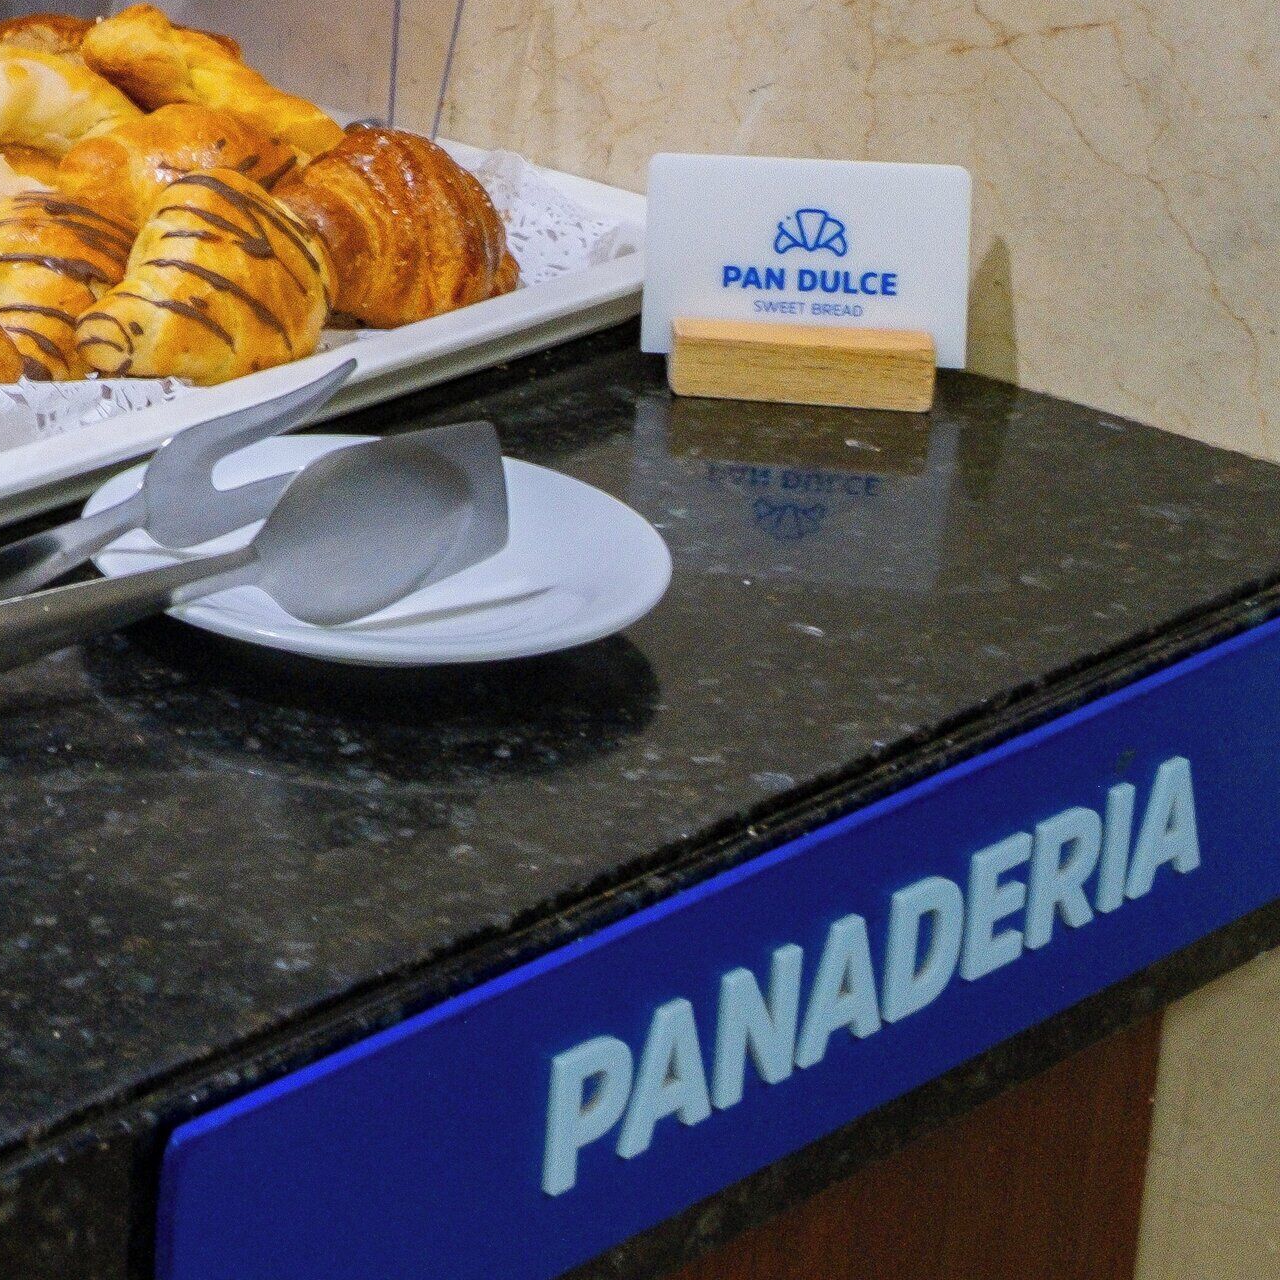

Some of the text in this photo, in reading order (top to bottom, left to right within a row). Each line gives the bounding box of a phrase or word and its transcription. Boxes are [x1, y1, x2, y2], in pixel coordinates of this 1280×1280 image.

[722, 265, 899, 296] PAN DULCE
[753, 299, 864, 318] SWEET BREAD
[542, 755, 1201, 1198] PANADERIA
